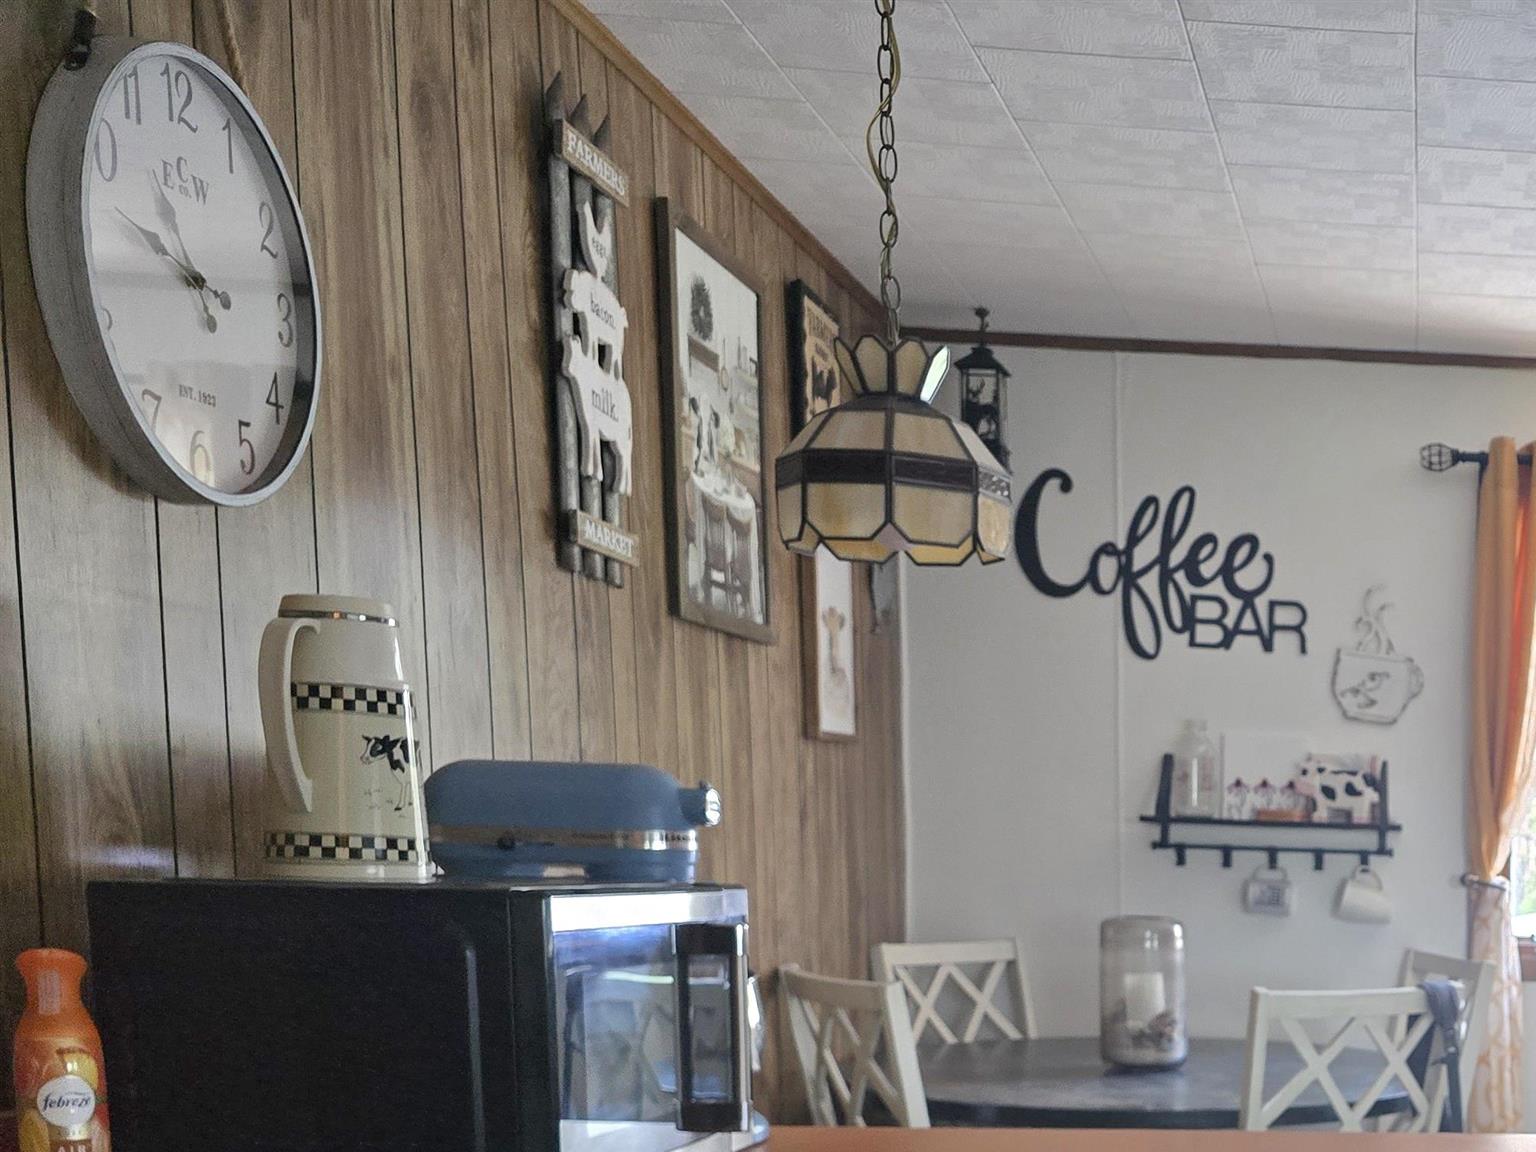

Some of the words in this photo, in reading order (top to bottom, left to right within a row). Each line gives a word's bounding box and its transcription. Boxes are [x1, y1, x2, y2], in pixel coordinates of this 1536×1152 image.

[123, 64, 142, 126] 11
[160, 62, 198, 133] 12
[95, 118, 118, 182] 0
[222, 117, 234, 174] 1
[567, 129, 626, 196] FARMERS
[259, 201, 278, 259] 2
[277, 293, 293, 348] 3
[141, 388, 162, 434] 7
[266, 371, 284, 425] 4
[190, 430, 210, 479] 6
[238, 418, 255, 475] 5
[585, 519, 634, 558] MARKET
[1013, 467, 1274, 660] Coffee
[1189, 594, 1307, 654] BAR
